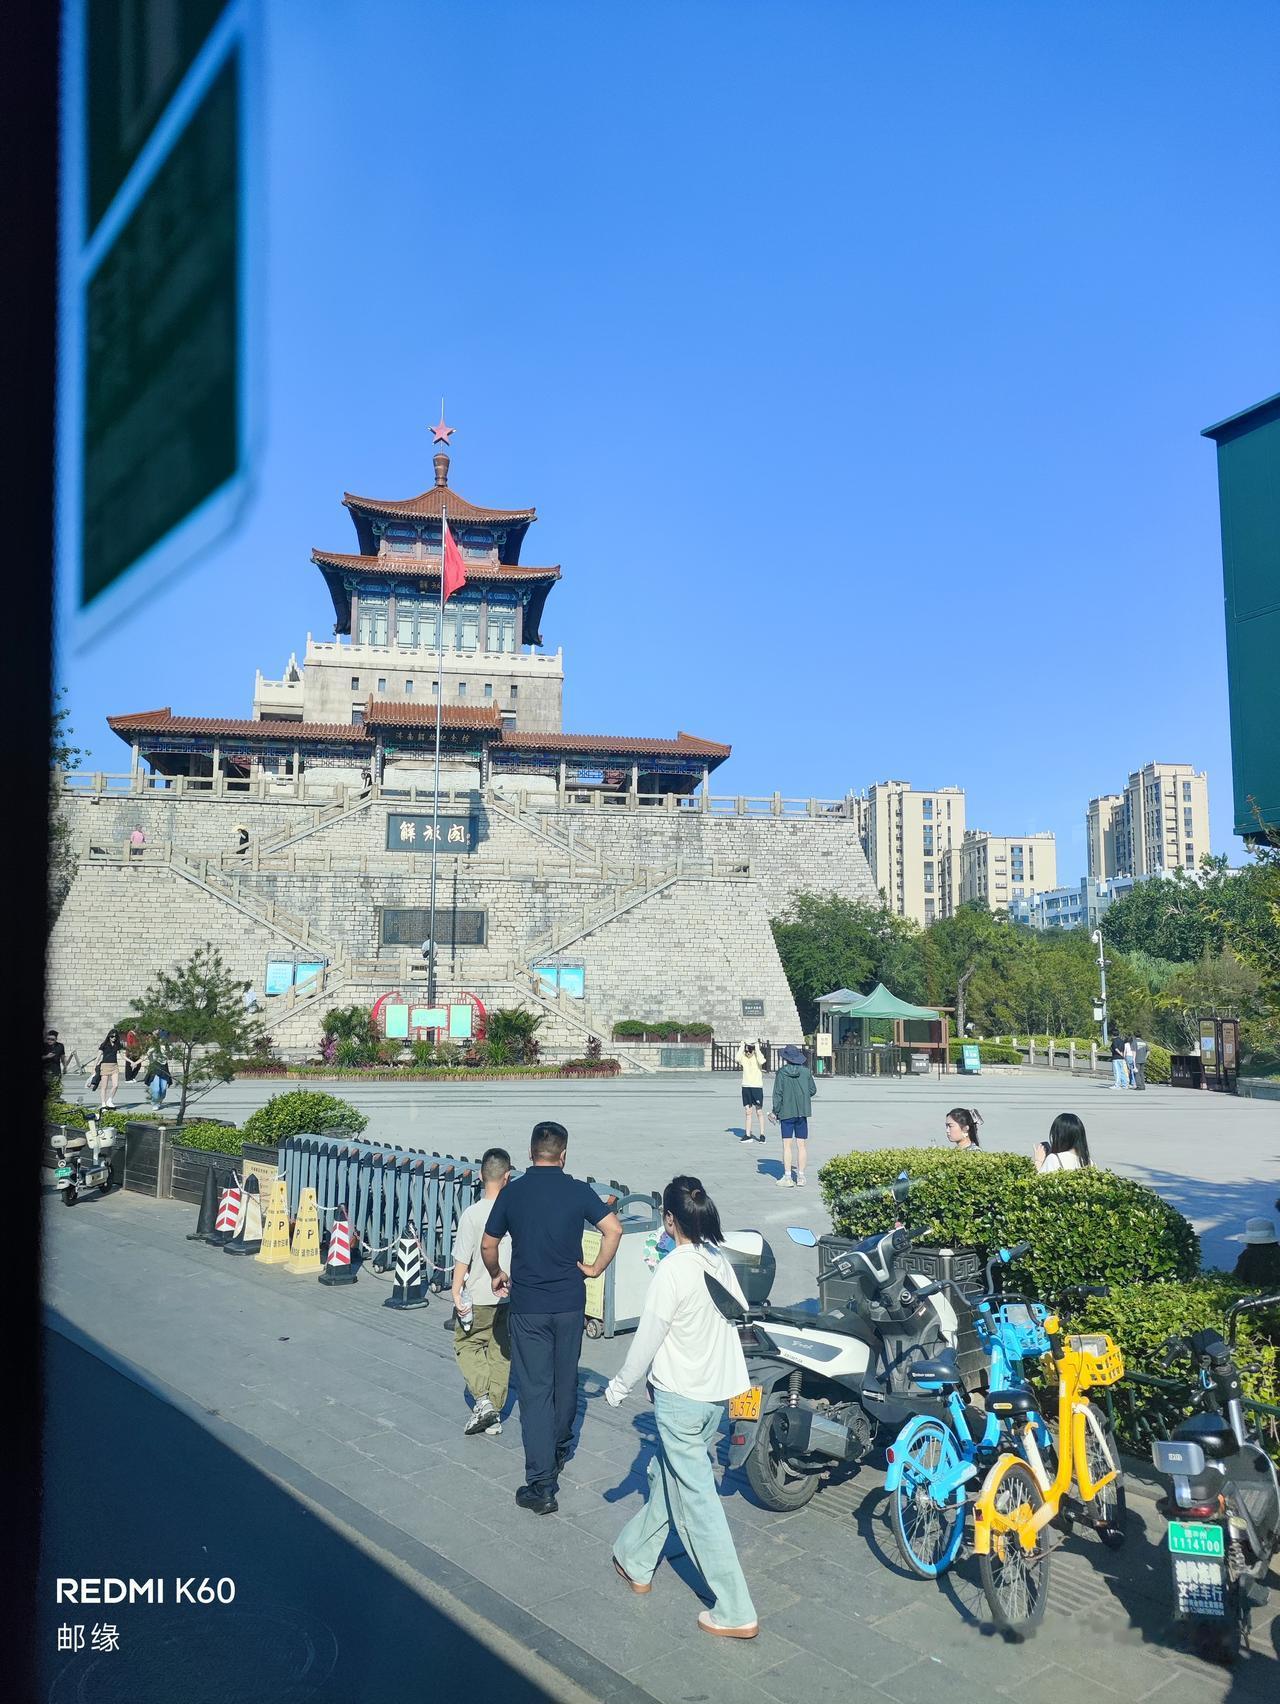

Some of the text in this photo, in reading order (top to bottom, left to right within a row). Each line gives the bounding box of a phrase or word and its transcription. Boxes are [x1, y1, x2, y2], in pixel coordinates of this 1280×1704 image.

[279, 1220, 285, 1231] P
[307, 1229, 315, 1240] P
[1173, 1536, 1220, 1553] 1114100
